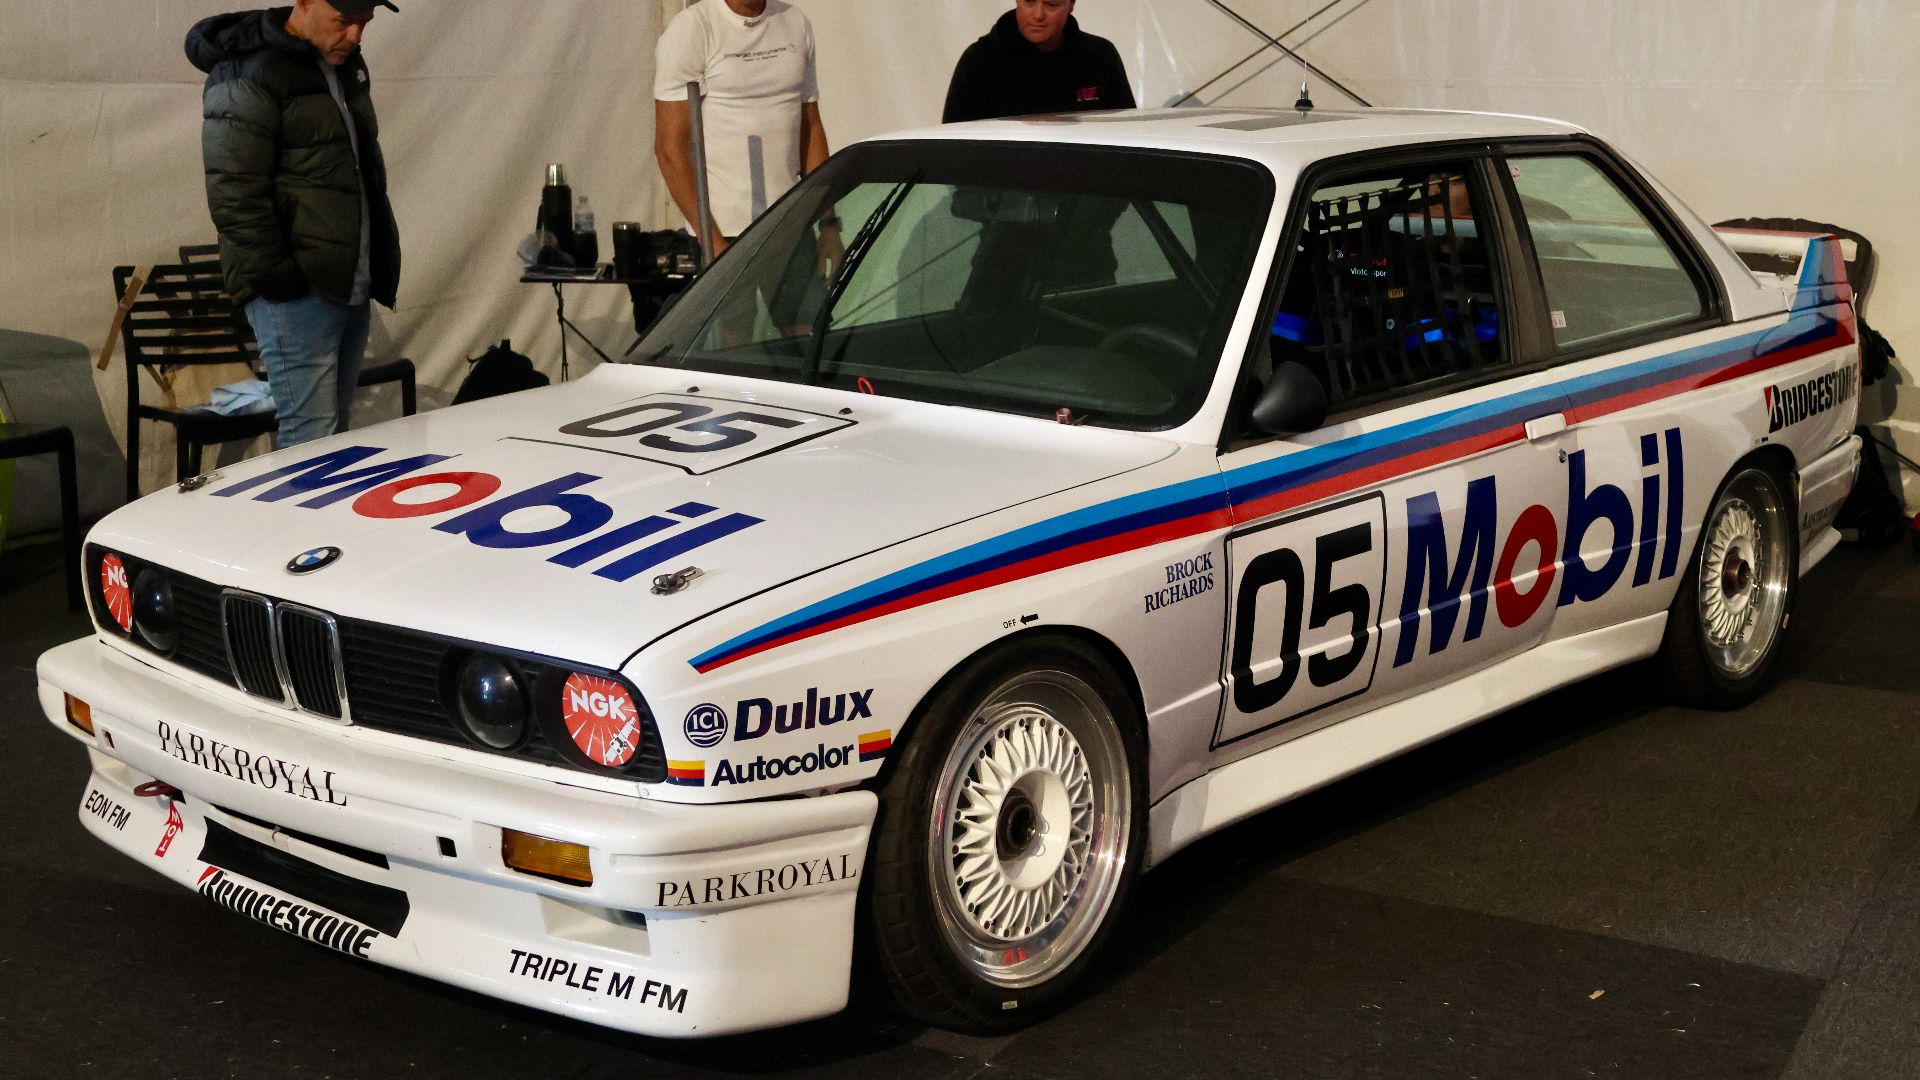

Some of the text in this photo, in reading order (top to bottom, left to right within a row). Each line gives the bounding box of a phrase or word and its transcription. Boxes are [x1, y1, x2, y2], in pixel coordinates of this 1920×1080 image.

[1763, 362, 1858, 434] BRIDGESTONE
[558, 402, 805, 453] 05
[209, 446, 766, 582] Mobil
[1165, 552, 1213, 584] BROCK
[1392, 427, 1685, 669] Mobil
[107, 566, 129, 589] NG
[1144, 573, 1214, 613] RICHARDS
[1002, 618, 1017, 629] OFF
[1231, 522, 1373, 713] 05
[570, 689, 627, 722] NGK
[692, 711, 719, 730] ICI
[733, 687, 874, 742] Dulux
[158, 720, 347, 807] PARKROYAL
[710, 743, 855, 787] Autocolor
[84, 789, 131, 831] EON FM
[655, 853, 857, 907] PARKROYAL
[509, 949, 688, 1014] TRIPLE M FM
